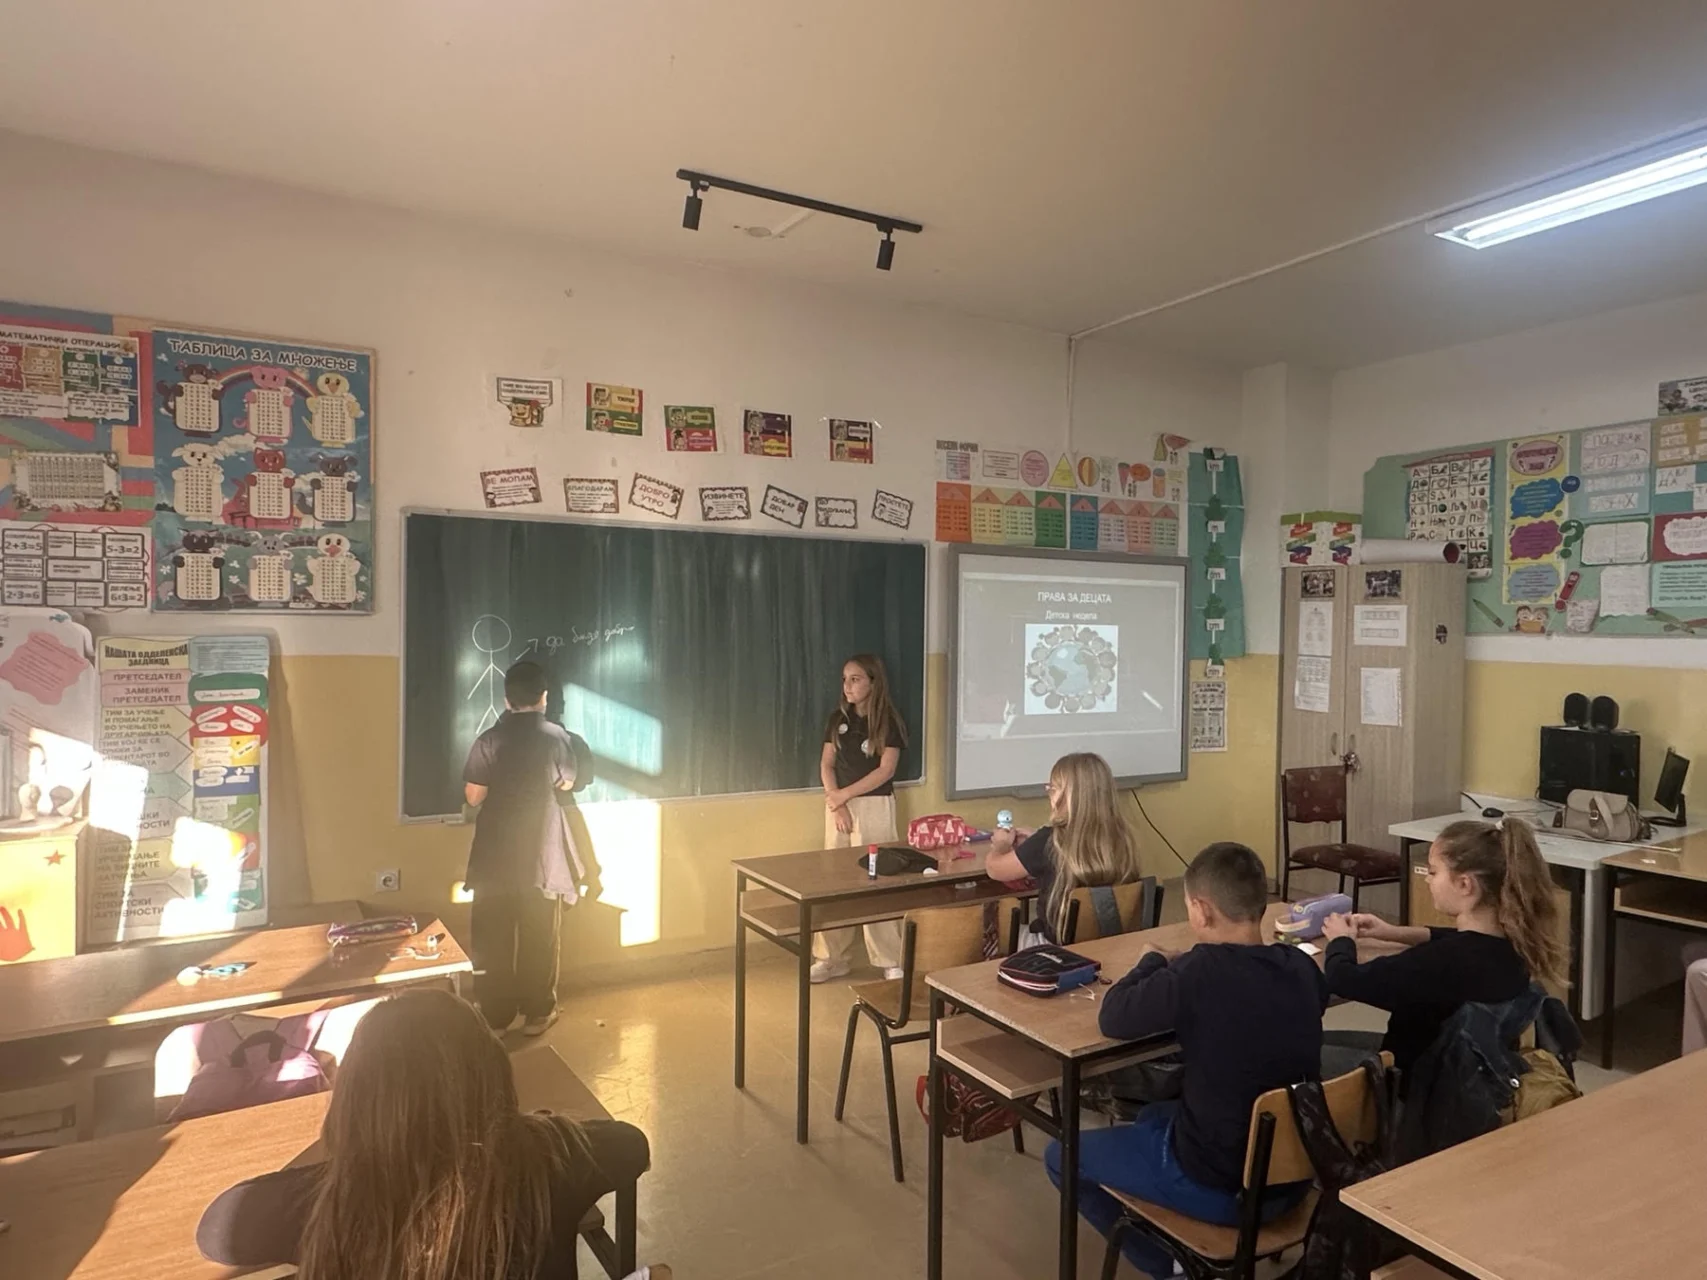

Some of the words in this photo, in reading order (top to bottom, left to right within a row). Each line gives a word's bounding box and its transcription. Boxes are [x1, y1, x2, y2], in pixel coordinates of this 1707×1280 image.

[71, 338, 121, 349] ОПЕРАЦИИ
[168, 339, 246, 360] ТАБЛИЦА
[252, 349, 274, 363] ЗА
[277, 351, 357, 372] МНОЖЕЊЕ
[1413, 469, 1420, 477] А
[1431, 466, 1439, 474] Б
[1451, 463, 1458, 472] В
[1472, 460, 1479, 469] Г
[1411, 481, 1419, 489] Д
[1450, 476, 1458, 485] Е
[639, 484, 670, 499] ДОБРО
[704, 492, 745, 500] ИЗВИНЕТЕ
[1411, 494, 1417, 502] З
[1450, 489, 1457, 498] И
[641, 494, 664, 507] УТРО
[769, 503, 785, 513] ДЕН
[1410, 507, 1417, 515] К
[1431, 504, 1438, 513] Л
[1470, 500, 1478, 509] М
[1410, 520, 1417, 528] Н
[1449, 516, 1456, 525] О
[1469, 513, 1476, 522] П
[1429, 530, 1436, 539] С
[1449, 529, 1455, 538] Т
[5, 542, 43, 551] 2+3=5
[107, 545, 140, 554] 5-3=2
[110, 594, 143, 602] 6:3=2
[1038, 592, 1065, 602] ПРАВА
[1067, 593, 1079, 602] ЗА
[1079, 593, 1112, 604] ДЕЦАТА
[1045, 610, 1070, 621] Детска
[105, 645, 137, 659] НАШАТА
[138, 644, 189, 659] ОДДЕЛЕНСКА
[546, 636, 565, 656] да
[128, 657, 170, 667] ЗАЕДНИЦА
[113, 673, 182, 681] ПРЕТСЕДАТЕЛ
[124, 687, 170, 695] ЗАМЕНИК
[112, 695, 182, 704] ПРЕТСЕДАТЕЛ
